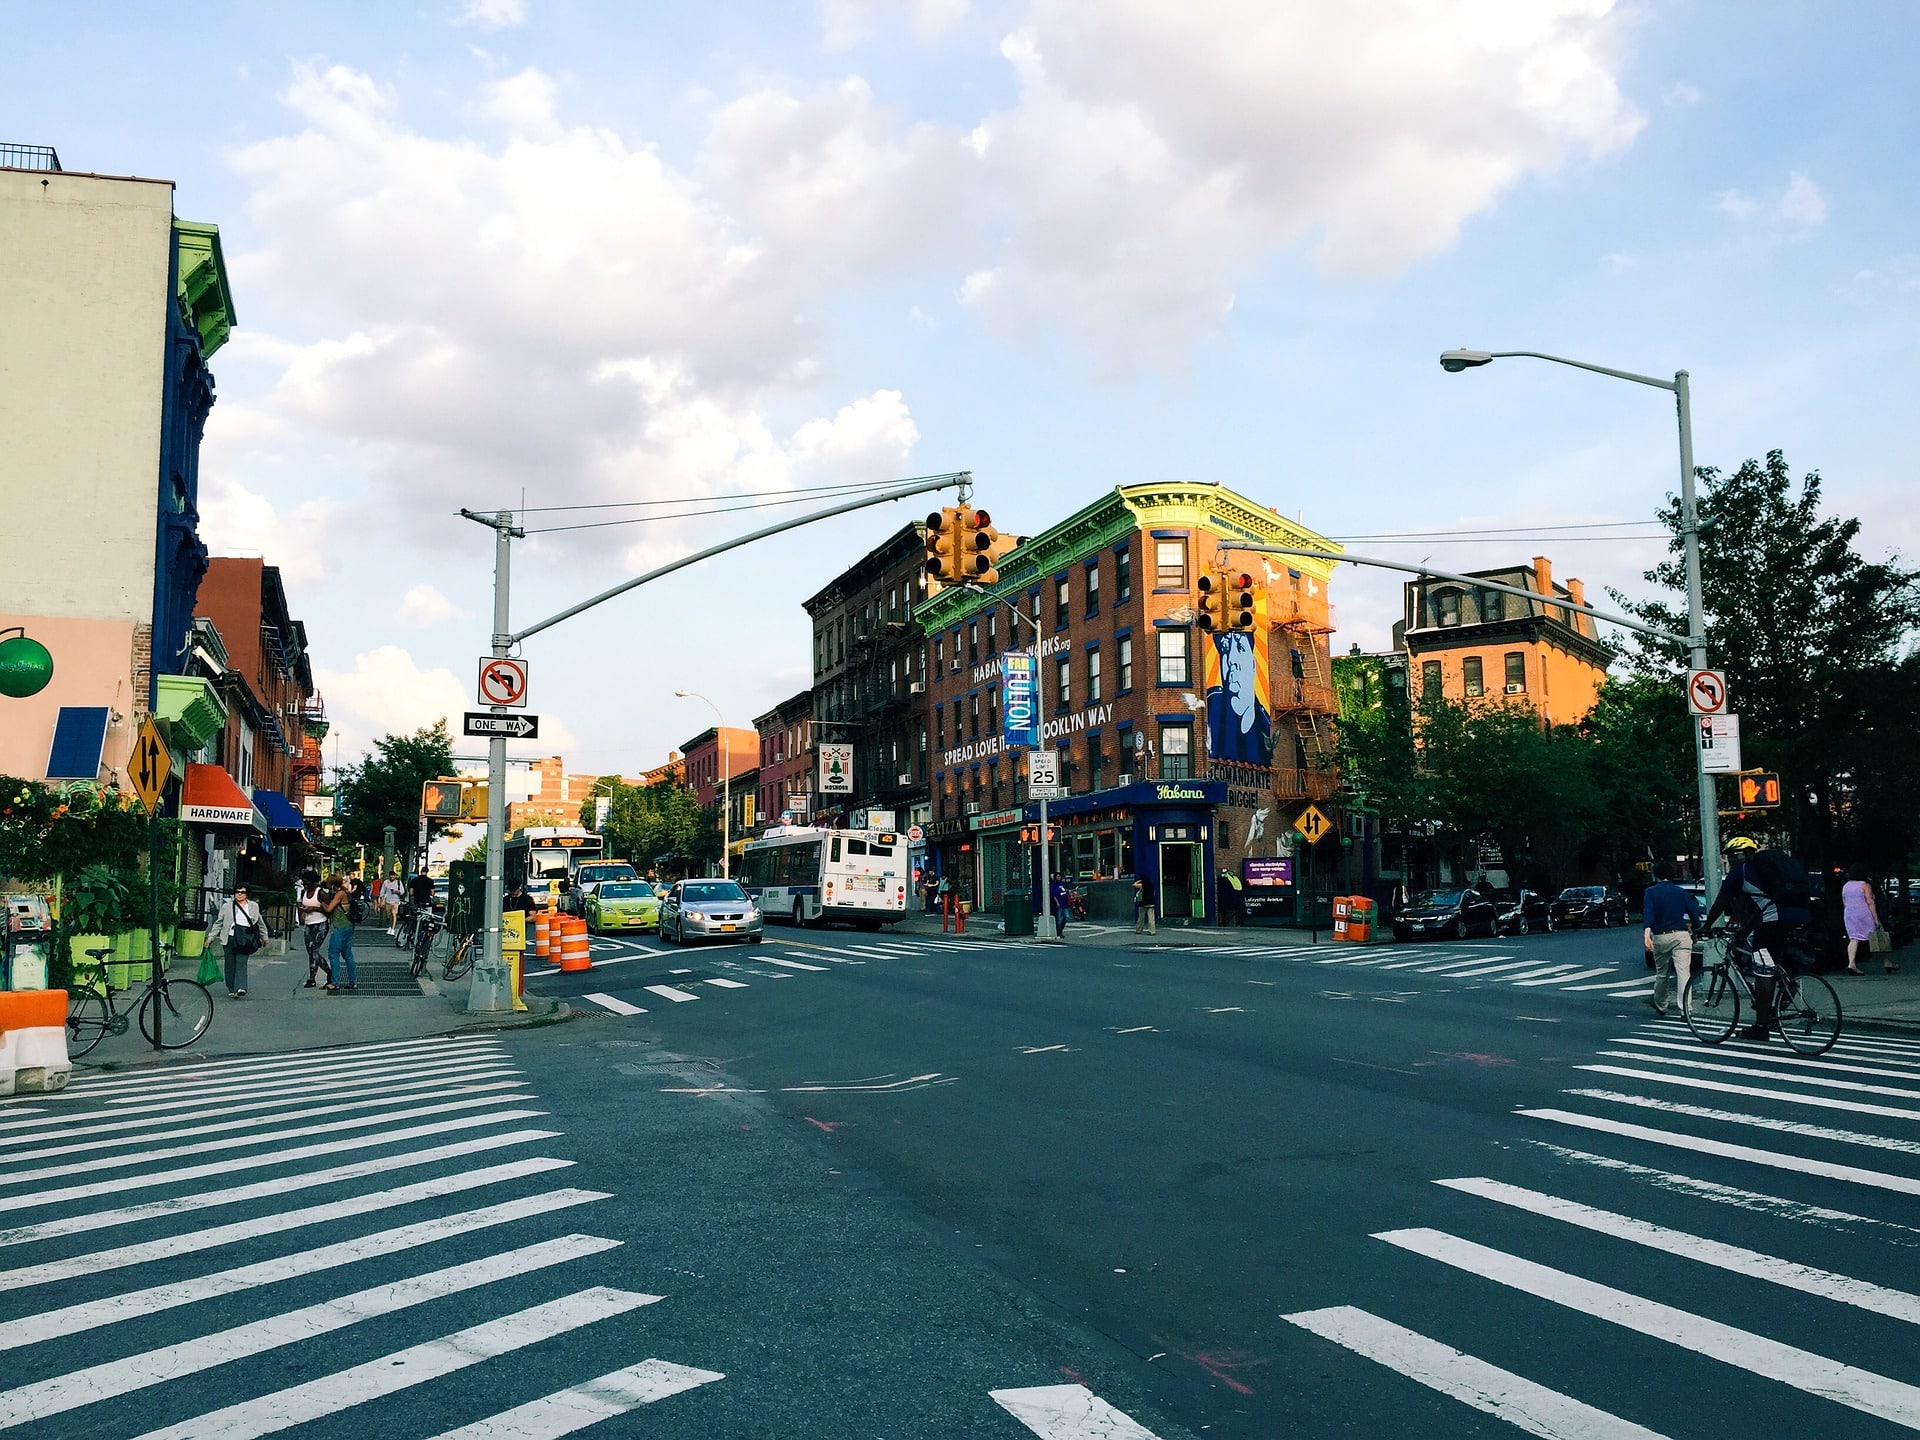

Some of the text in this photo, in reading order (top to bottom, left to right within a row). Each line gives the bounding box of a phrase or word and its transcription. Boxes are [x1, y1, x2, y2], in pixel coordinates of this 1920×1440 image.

[1008, 671, 1032, 731] FULTON
[475, 719, 528, 731] ONE WAY
[944, 744, 973, 766] SPREAD
[1088, 703, 1113, 728] WAY
[1033, 770, 1055, 784] 25
[1156, 784, 1205, 800] Habana
[190, 807, 251, 821] HARDWARE
[936, 819, 962, 836] PIZZA
[216, 836, 244, 847] ATM
